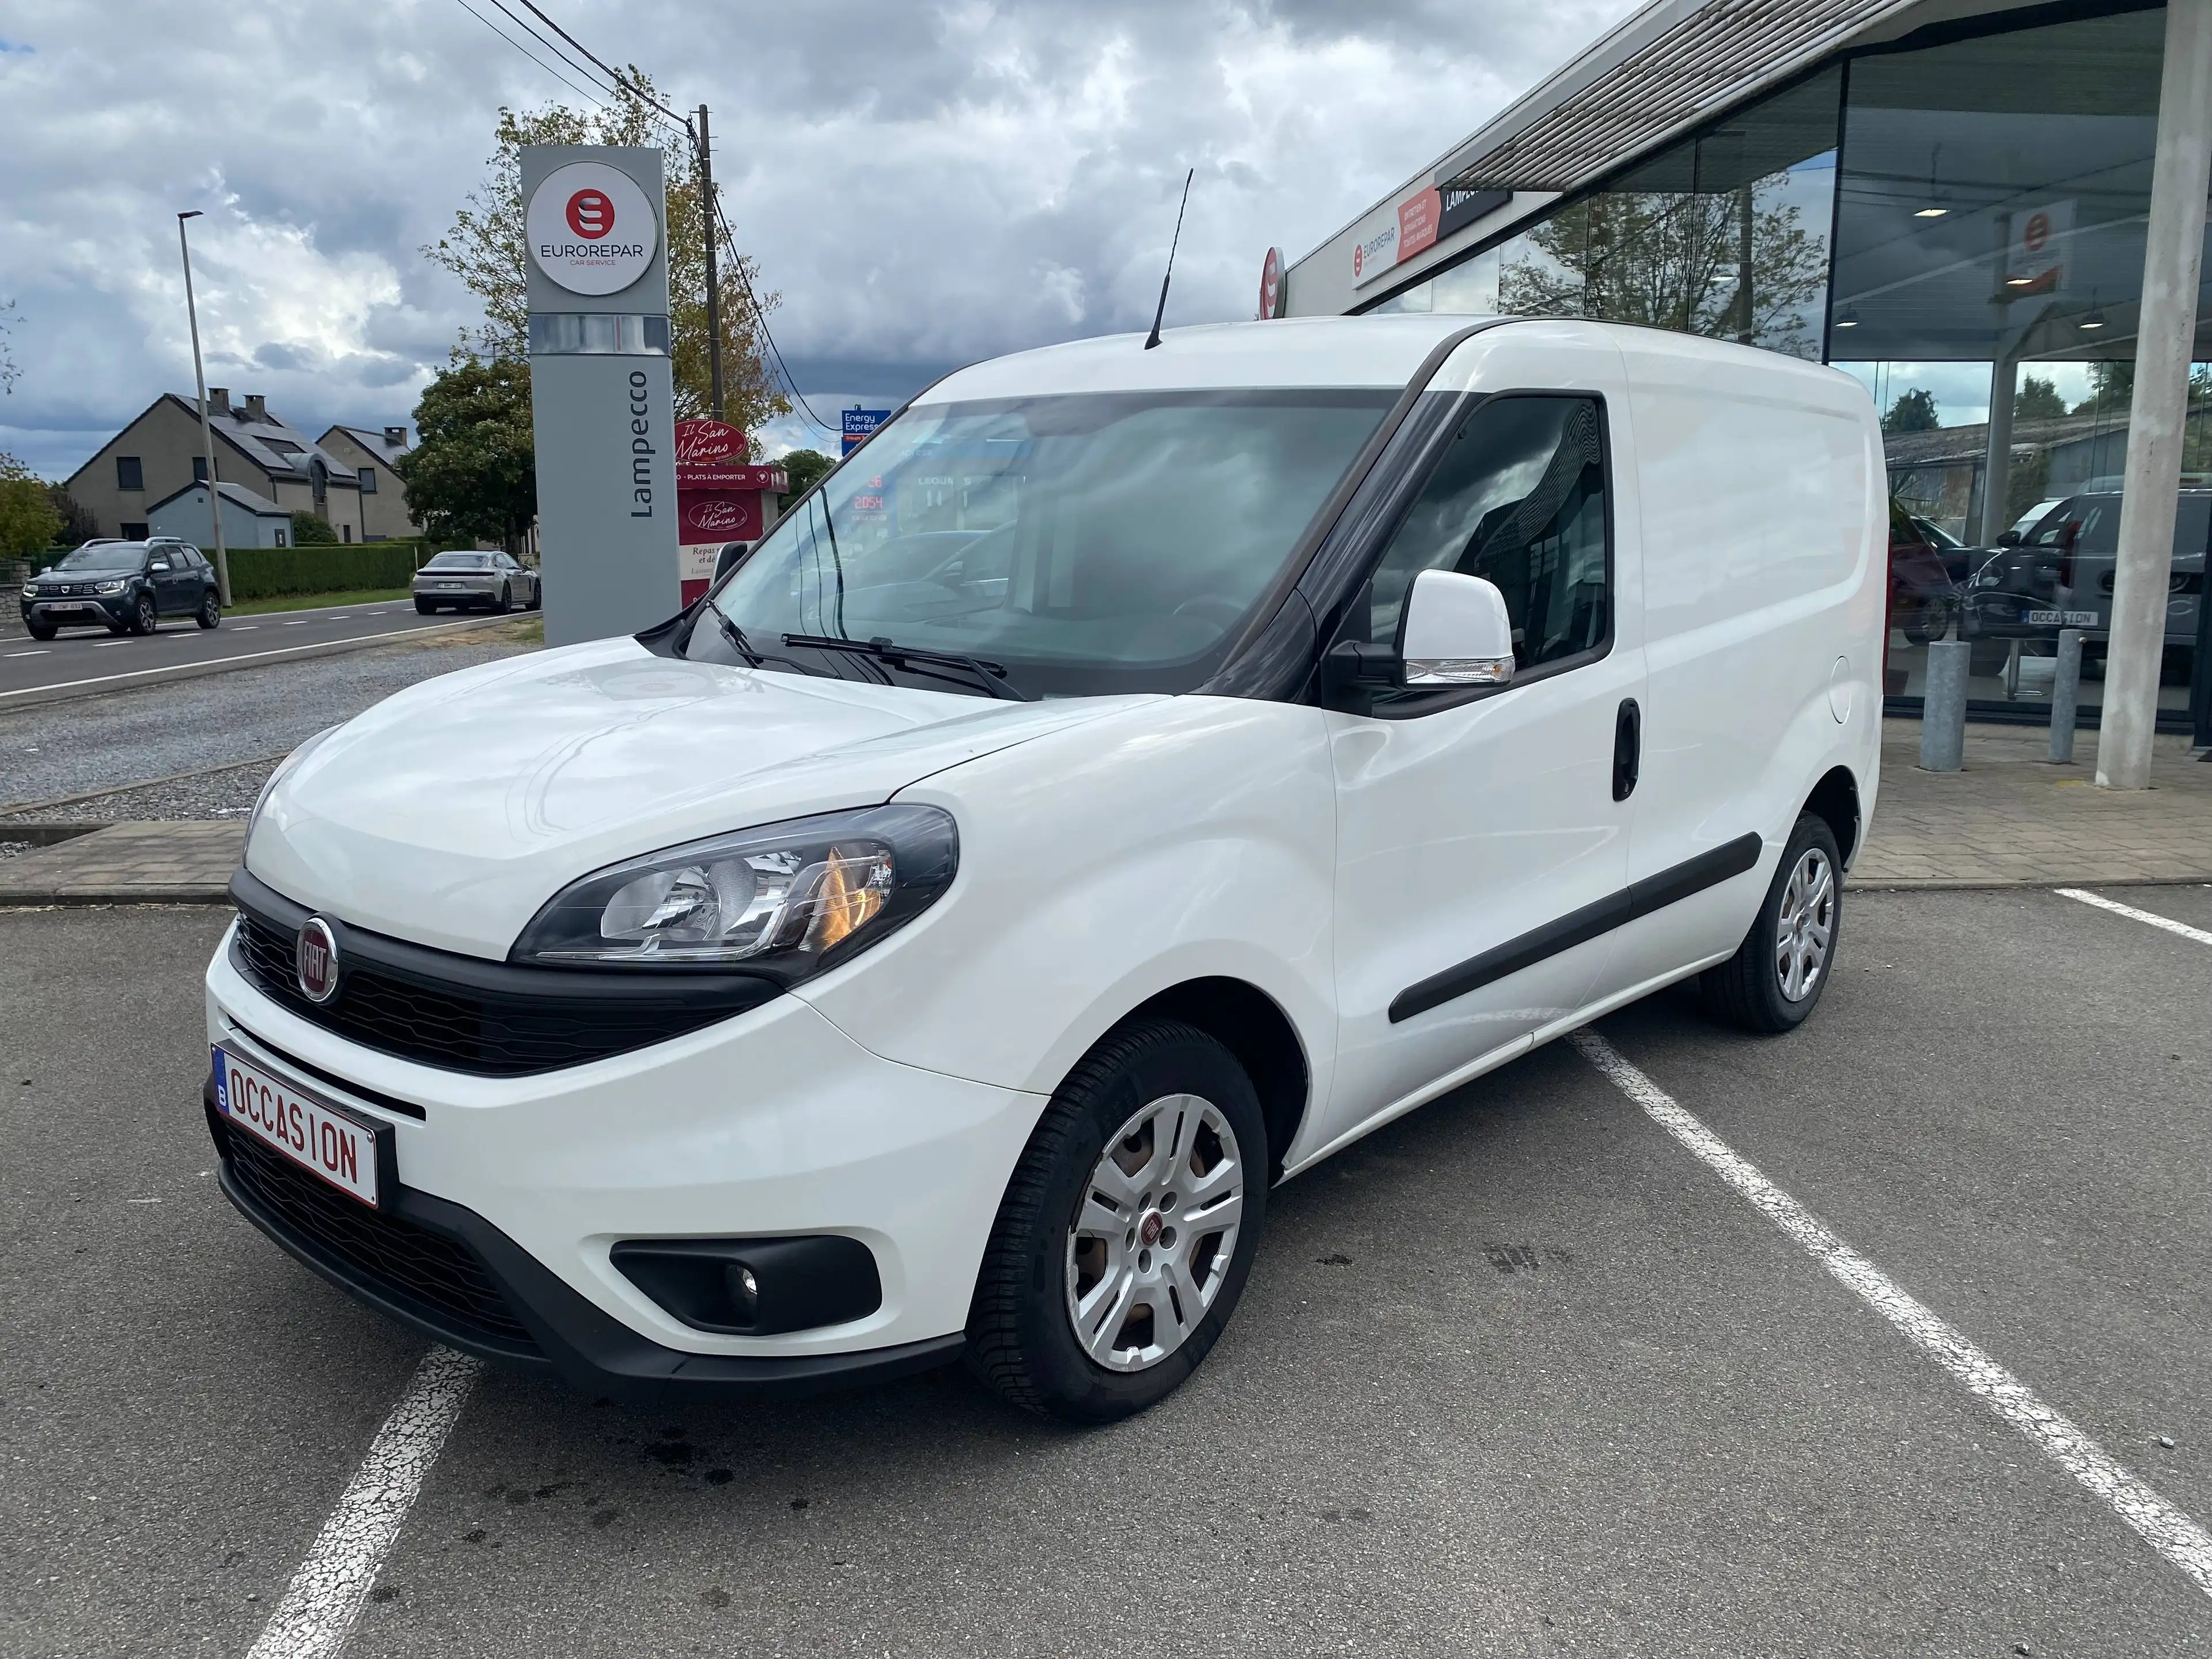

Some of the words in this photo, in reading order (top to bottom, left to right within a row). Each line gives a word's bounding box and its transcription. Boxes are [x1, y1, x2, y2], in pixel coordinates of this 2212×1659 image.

[540, 244, 643, 257] EUROREPAR
[1363, 227, 1395, 259] EUROREPAR
[845, 414, 875, 423] Energy
[629, 370, 656, 517] Lampecco
[698, 421, 729, 445] San
[675, 436, 728, 460] Marino
[698, 513, 736, 529] Marino
[714, 501, 736, 518] San
[693, 547, 715, 556] Repas
[304, 941, 327, 982] FIAT
[217, 1084, 226, 1107] B
[230, 1068, 357, 1184] OCCASION
[1145, 1218, 1159, 1240] FIAT
